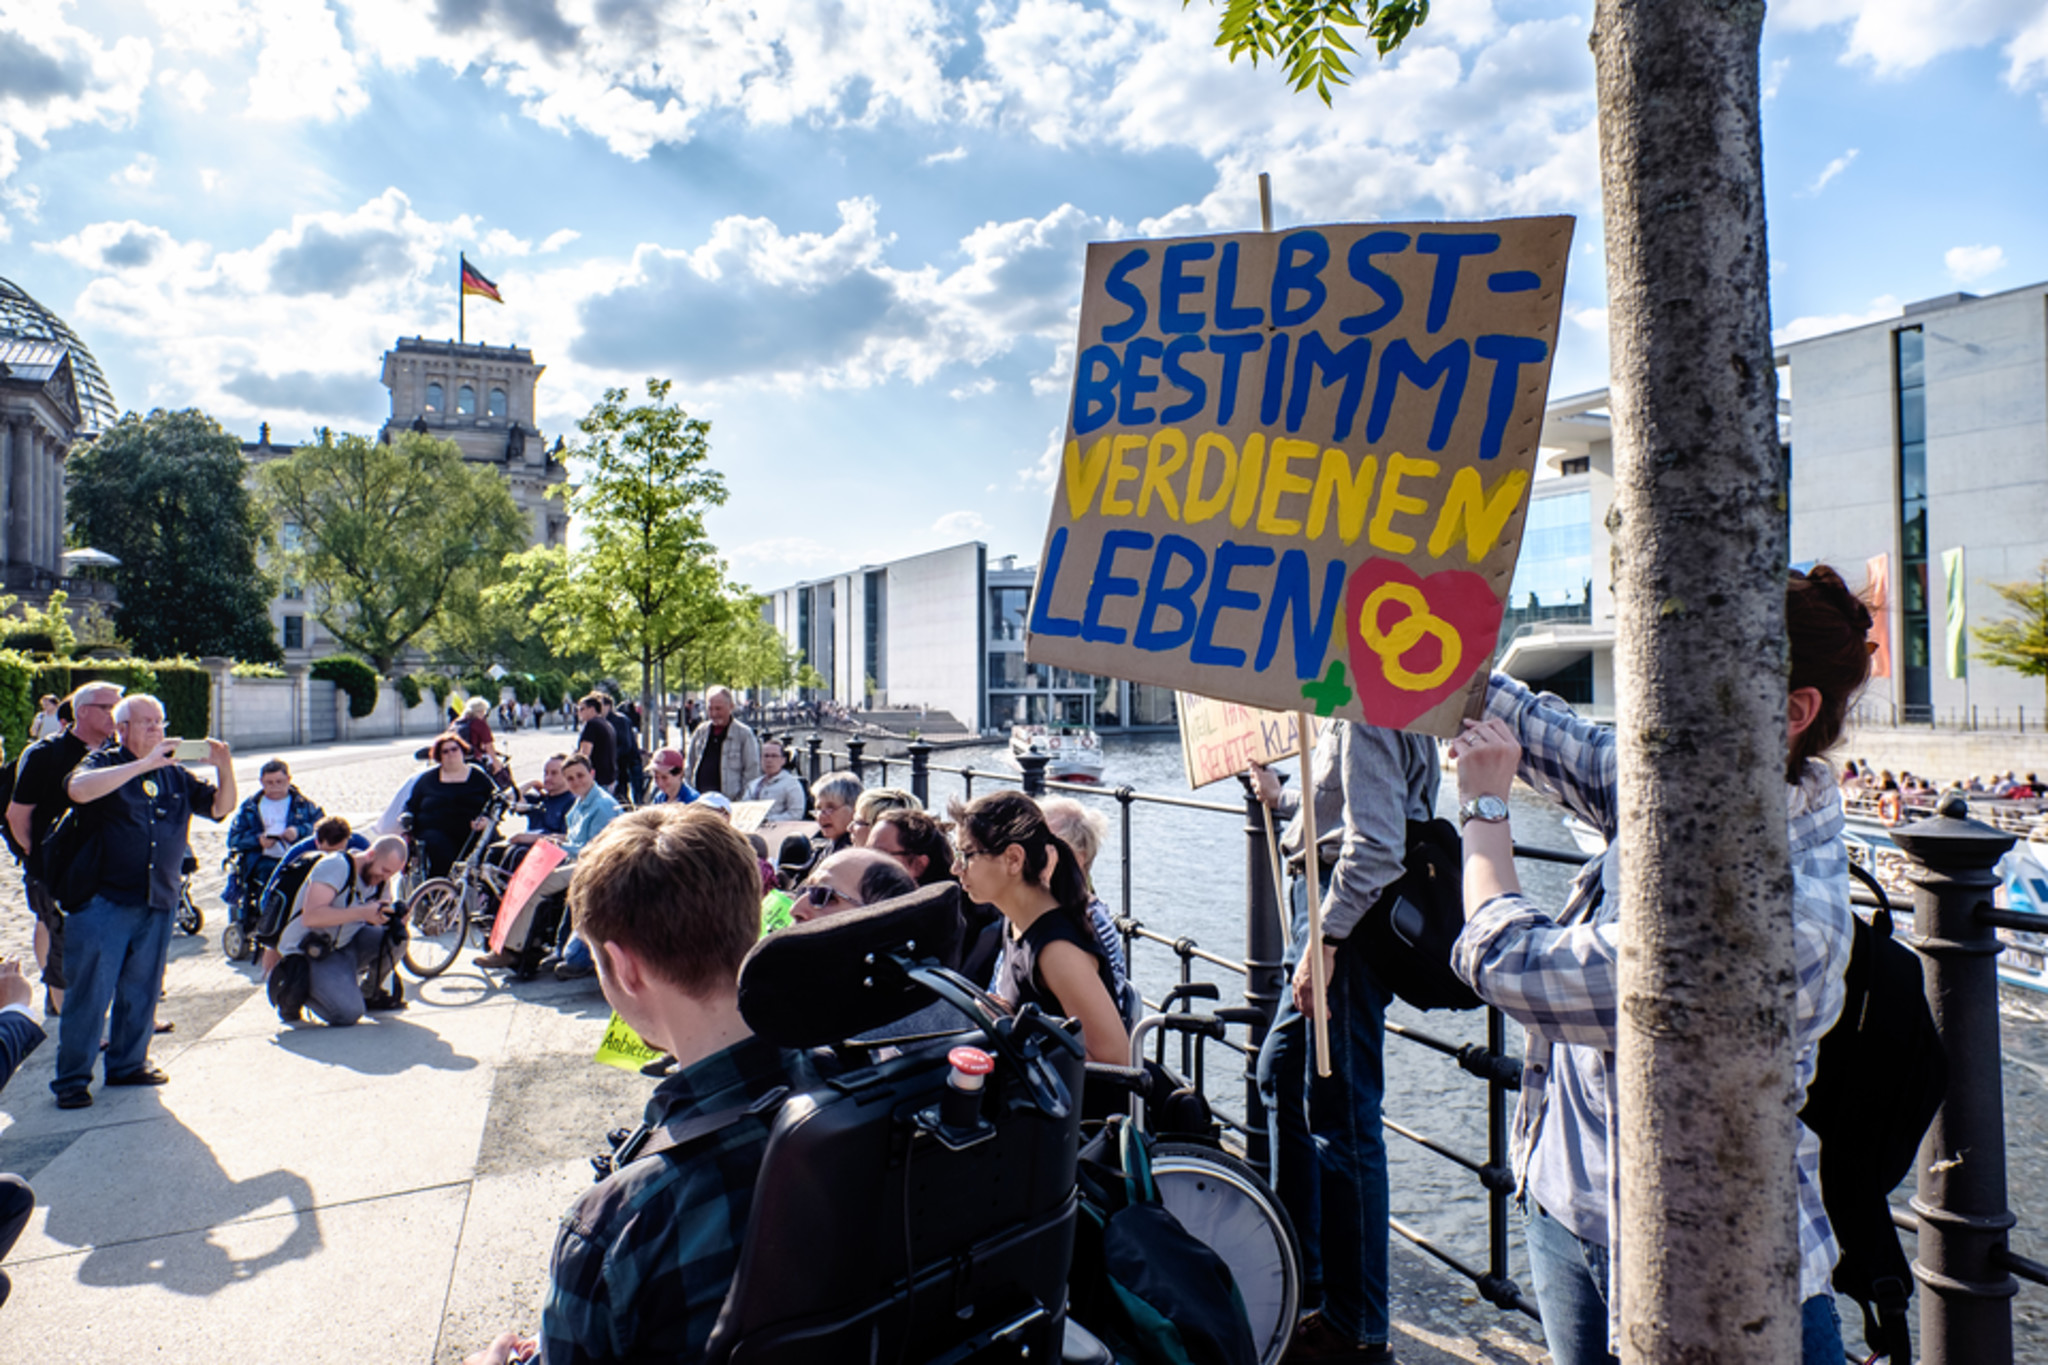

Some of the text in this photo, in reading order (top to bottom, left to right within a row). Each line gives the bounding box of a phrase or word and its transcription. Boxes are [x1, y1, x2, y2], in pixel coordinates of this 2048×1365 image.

[1101, 230, 1542, 343] SELBST-
[1072, 330, 1549, 460] BESTIMMT
[1063, 427, 1531, 563] VERDIENEN
[1029, 526, 1347, 680] LEBEN
